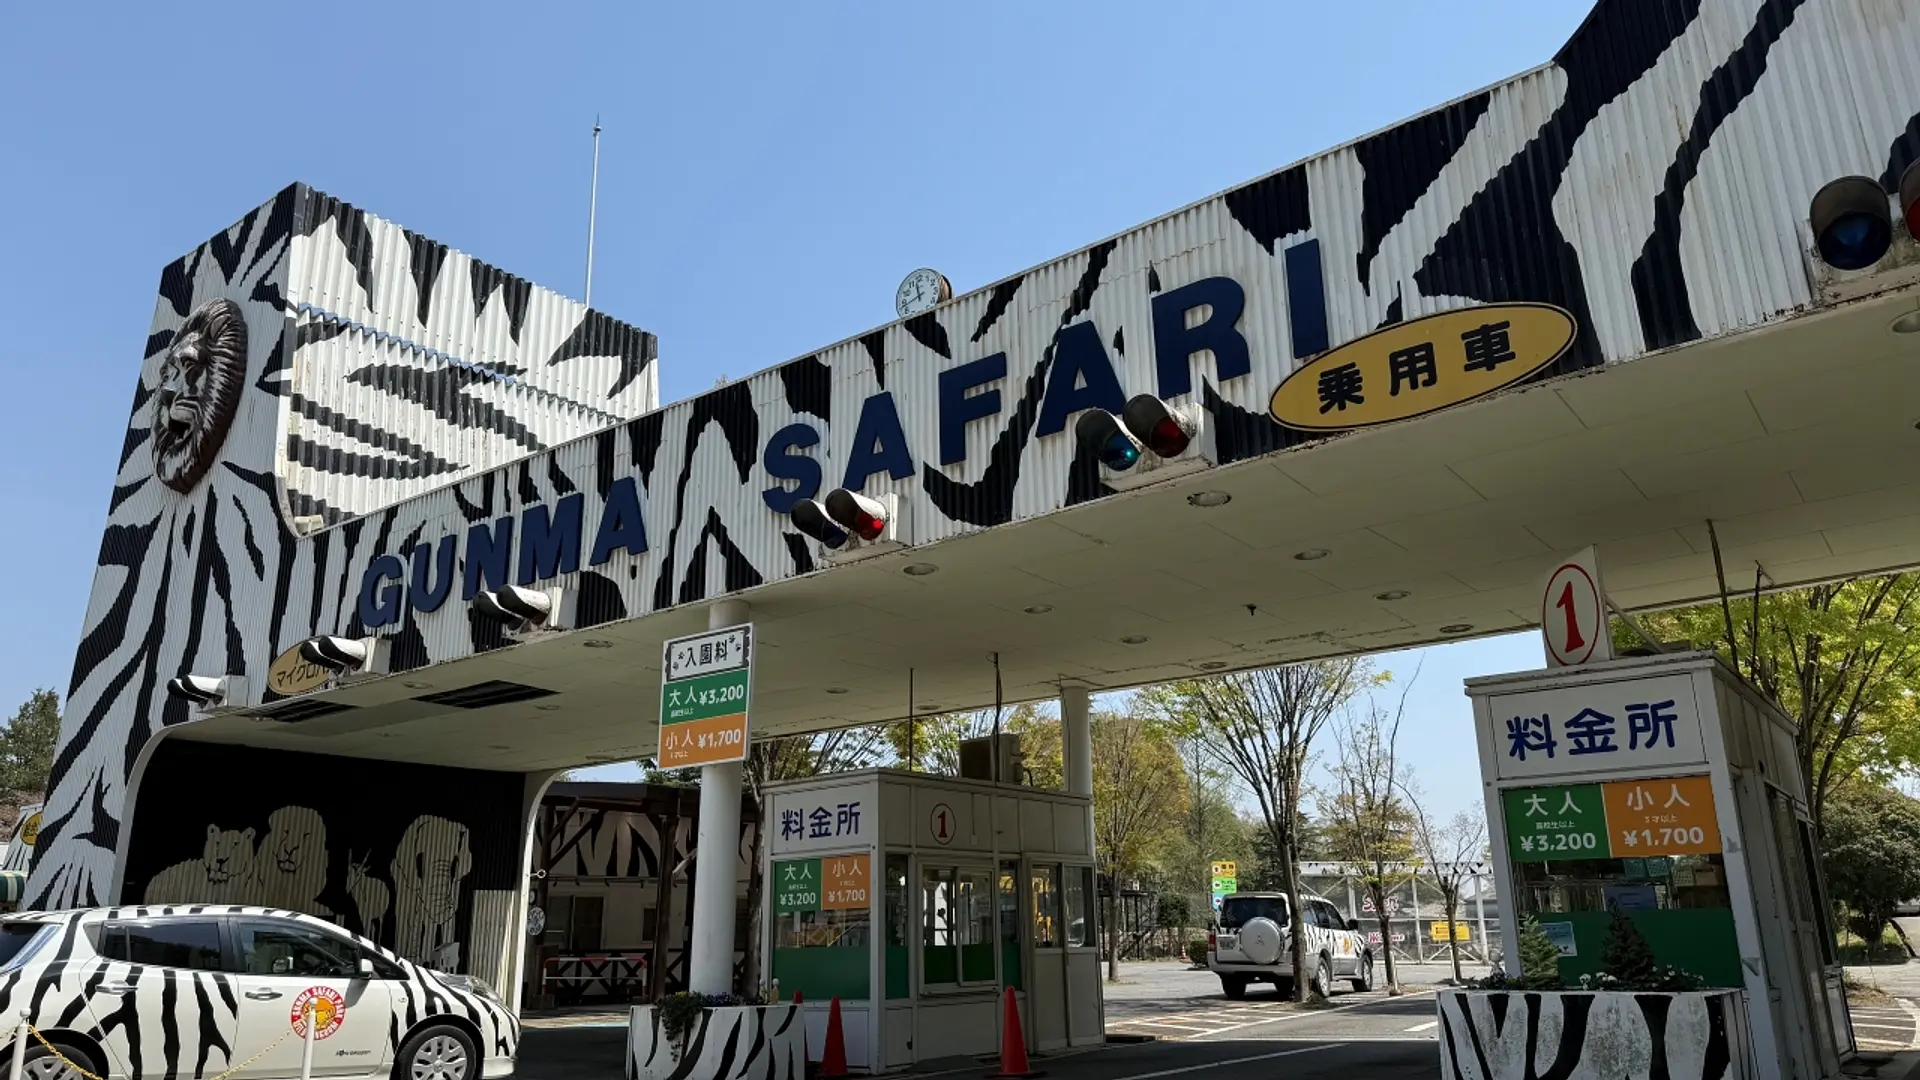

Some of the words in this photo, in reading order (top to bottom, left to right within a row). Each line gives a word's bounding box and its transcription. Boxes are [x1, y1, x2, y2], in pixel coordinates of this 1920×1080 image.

[1317, 320, 1516, 415] 乗用車
[359, 476, 649, 628] GUNMA
[762, 239, 1329, 514] SAFARI
[1556, 581, 1585, 653] 1
[685, 639, 728, 668] 入園料
[669, 685, 697, 708] 大人
[699, 684, 744, 706] ¥3,200
[665, 728, 694, 750] 小人
[698, 728, 742, 749] ¥1,700
[1506, 699, 1678, 761] 料金所
[1523, 791, 1582, 817] 大人
[1627, 783, 1690, 811] 小人
[781, 801, 861, 841] 料金所
[937, 810, 948, 838] 1
[1520, 832, 1597, 852] ¥3,200
[1623, 826, 1704, 847] ¥1,700
[784, 863, 812, 881] 大人
[832, 859, 863, 877] 小人
[780, 892, 816, 906] ¥3,200
[828, 889, 866, 903] ¥1,700
